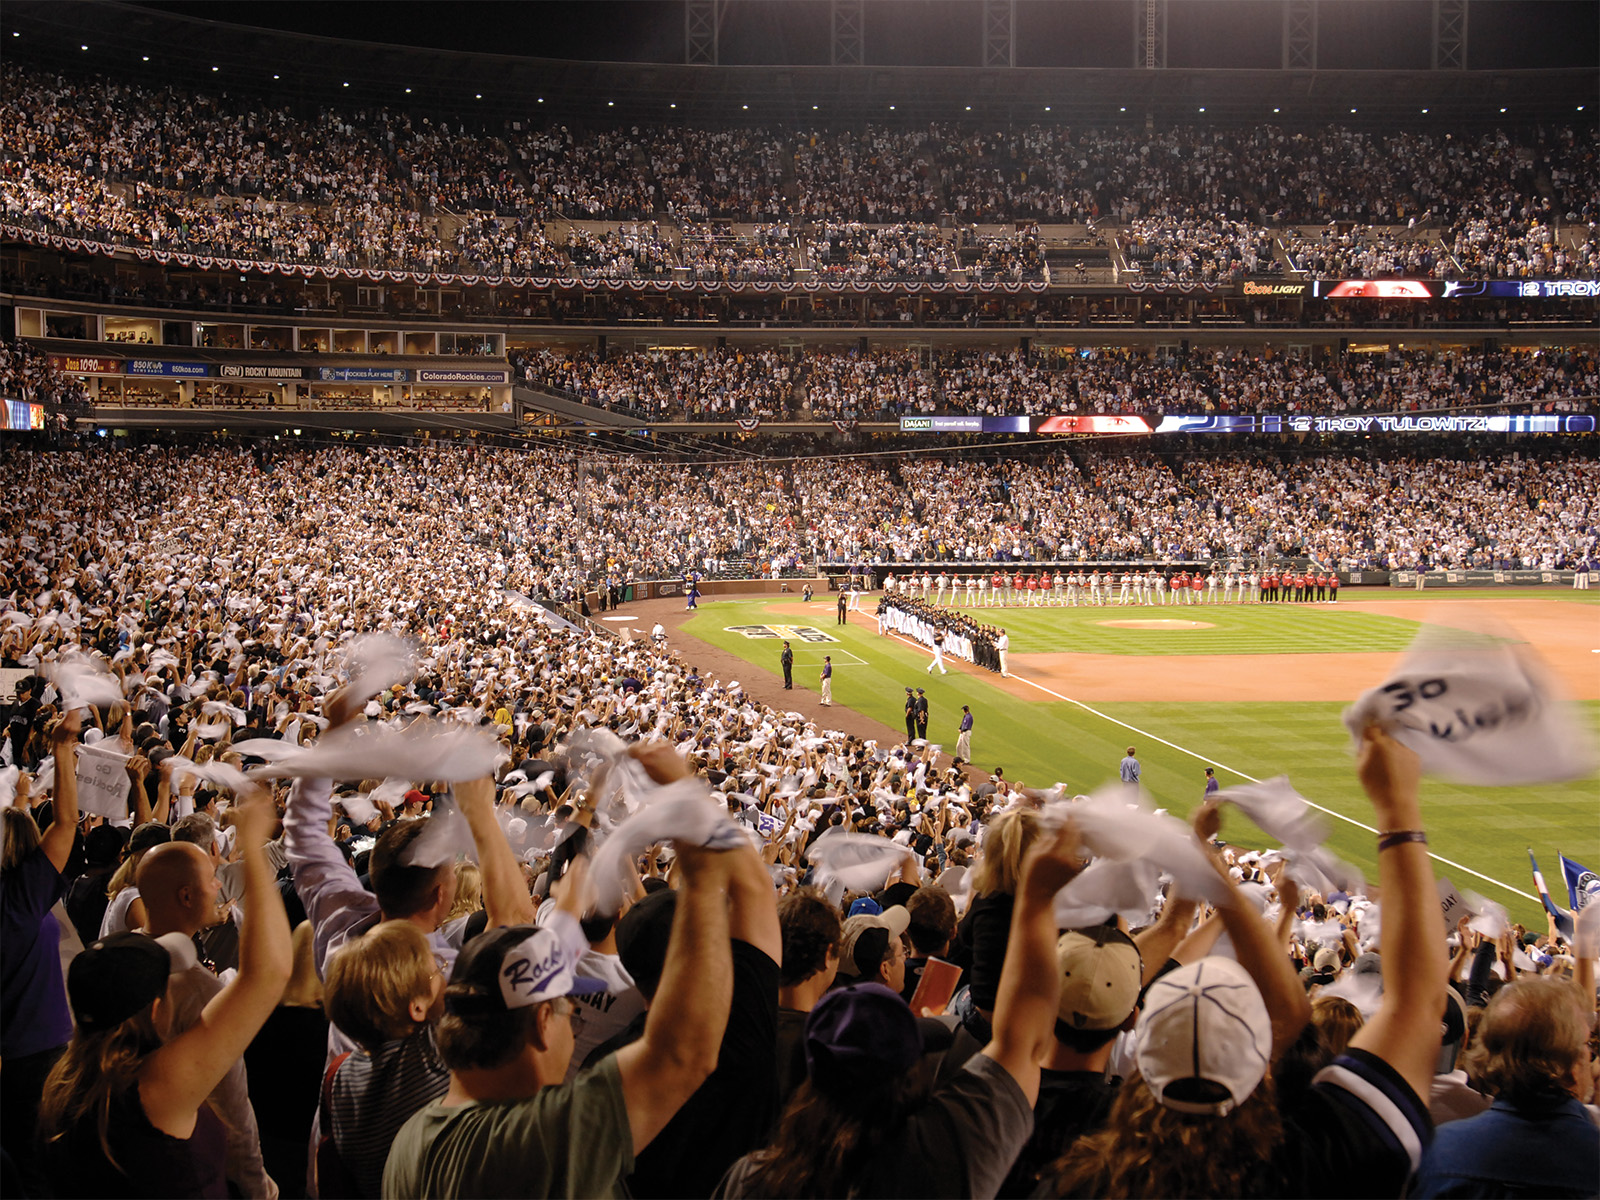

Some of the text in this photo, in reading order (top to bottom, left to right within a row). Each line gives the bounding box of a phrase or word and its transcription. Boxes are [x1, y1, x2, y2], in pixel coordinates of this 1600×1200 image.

[1244, 281, 1305, 295] Coors LIGHT
[1544, 281, 1600, 297] TROY
[80, 358, 98, 371] 1090
[172, 365, 204, 374] 850koa.com
[245, 367, 267, 377] ROCKY
[267, 367, 302, 378] MOUNTAIN
[422, 372, 503, 382] ColoradoRockies.com
[904, 419, 931, 429] DASANI
[1316, 416, 1373, 431] TROY
